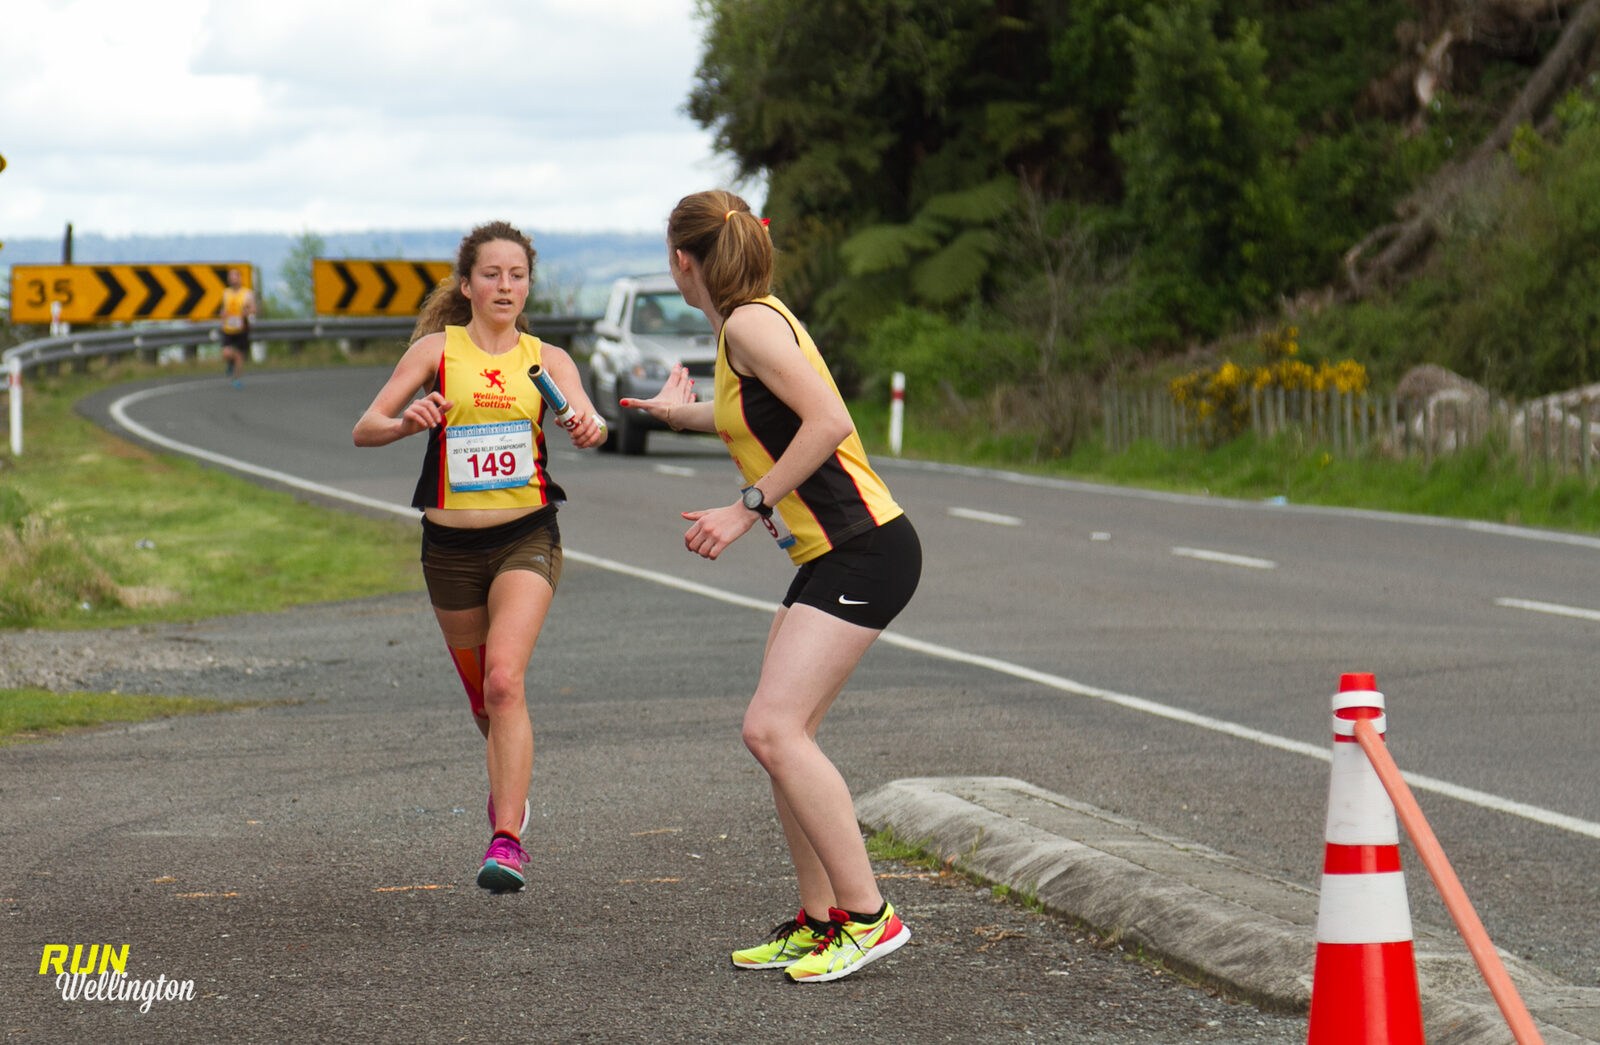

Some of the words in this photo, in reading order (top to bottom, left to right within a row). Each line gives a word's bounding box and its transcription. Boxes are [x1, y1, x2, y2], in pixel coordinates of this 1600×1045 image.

[26, 279, 74, 308] 35
[473, 392, 516, 402] Wellington
[474, 399, 511, 409] Scottish
[495, 442, 527, 451] CHAMPIONSHIPS
[467, 451, 516, 478] 149
